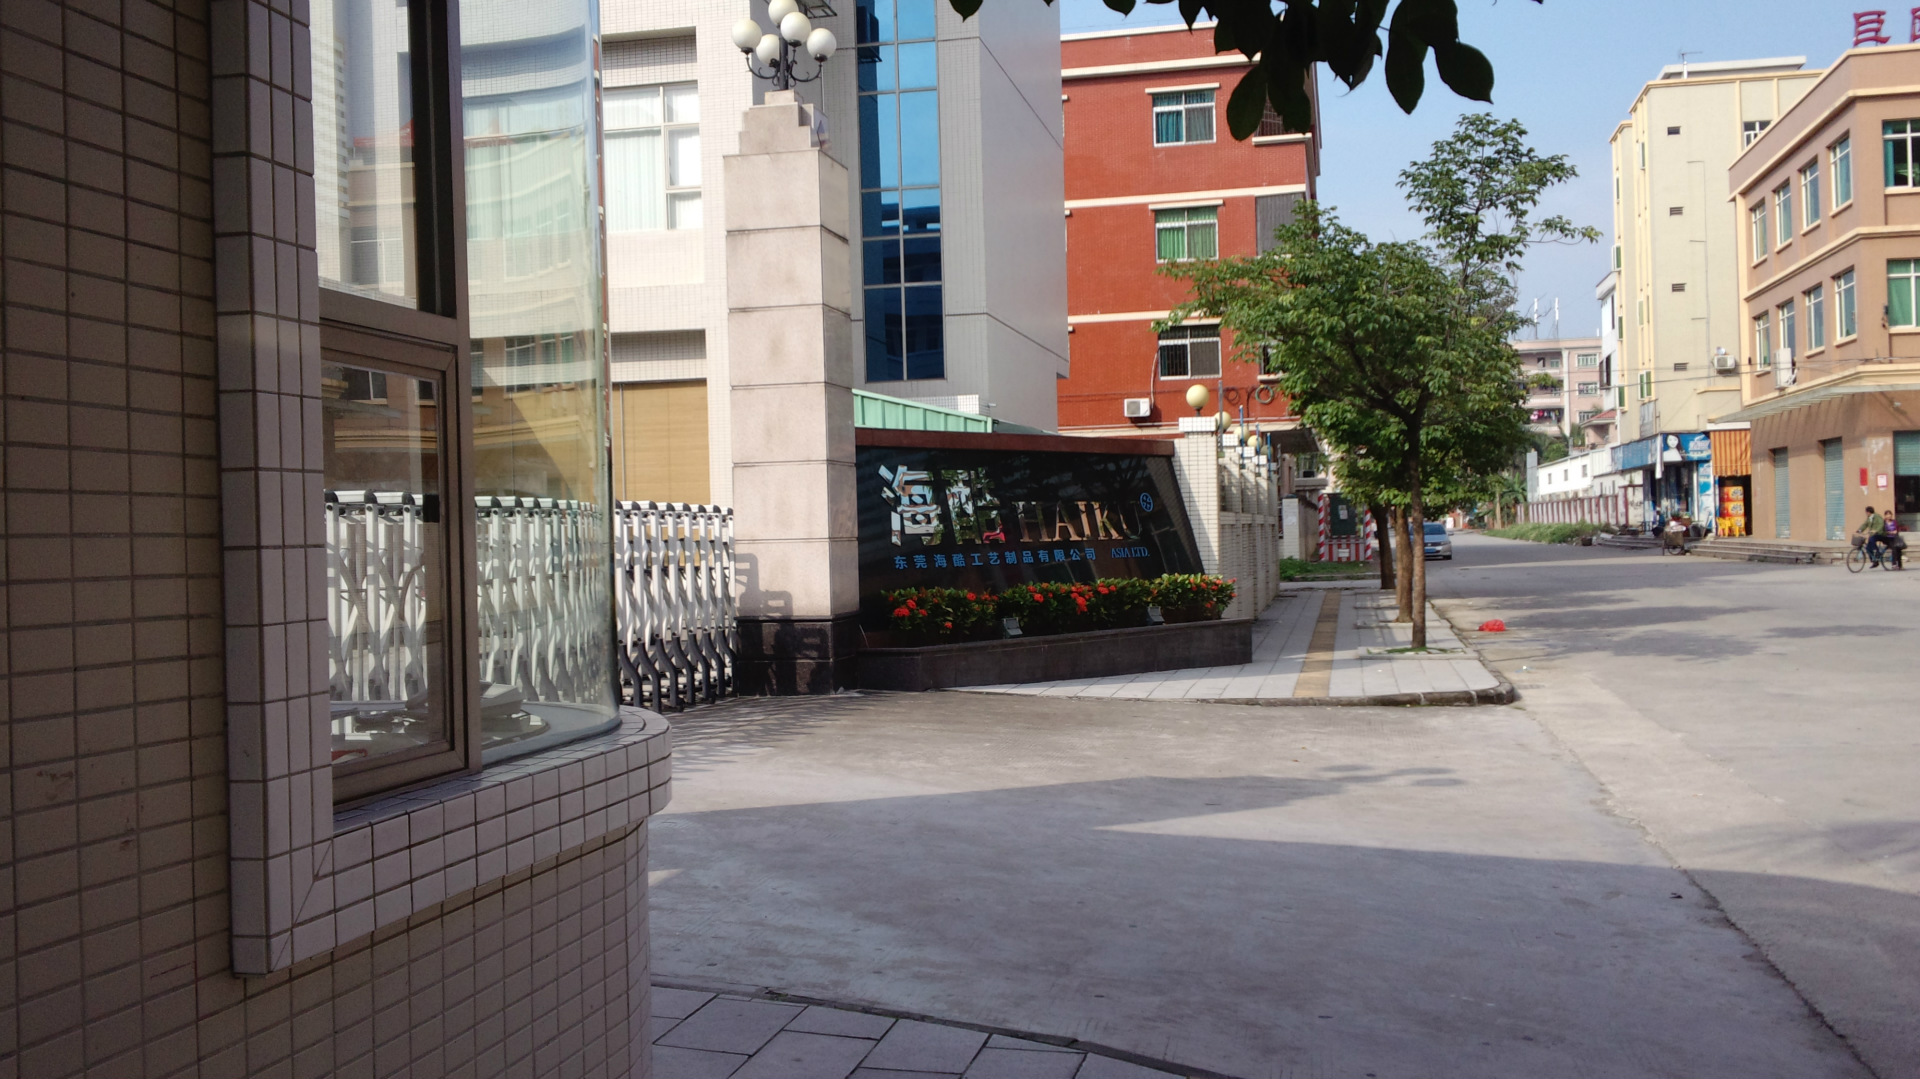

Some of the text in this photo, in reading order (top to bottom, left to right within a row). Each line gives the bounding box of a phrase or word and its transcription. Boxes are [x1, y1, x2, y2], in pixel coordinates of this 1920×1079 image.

[1853, 6, 1920, 47] 巨
[878, 464, 1006, 547] 海酷
[1011, 500, 1143, 543] HAIKU
[893, 547, 1097, 570] 东莞海酷工艺制品有限公司
[1111, 546, 1150, 559] ASIA LTD.
